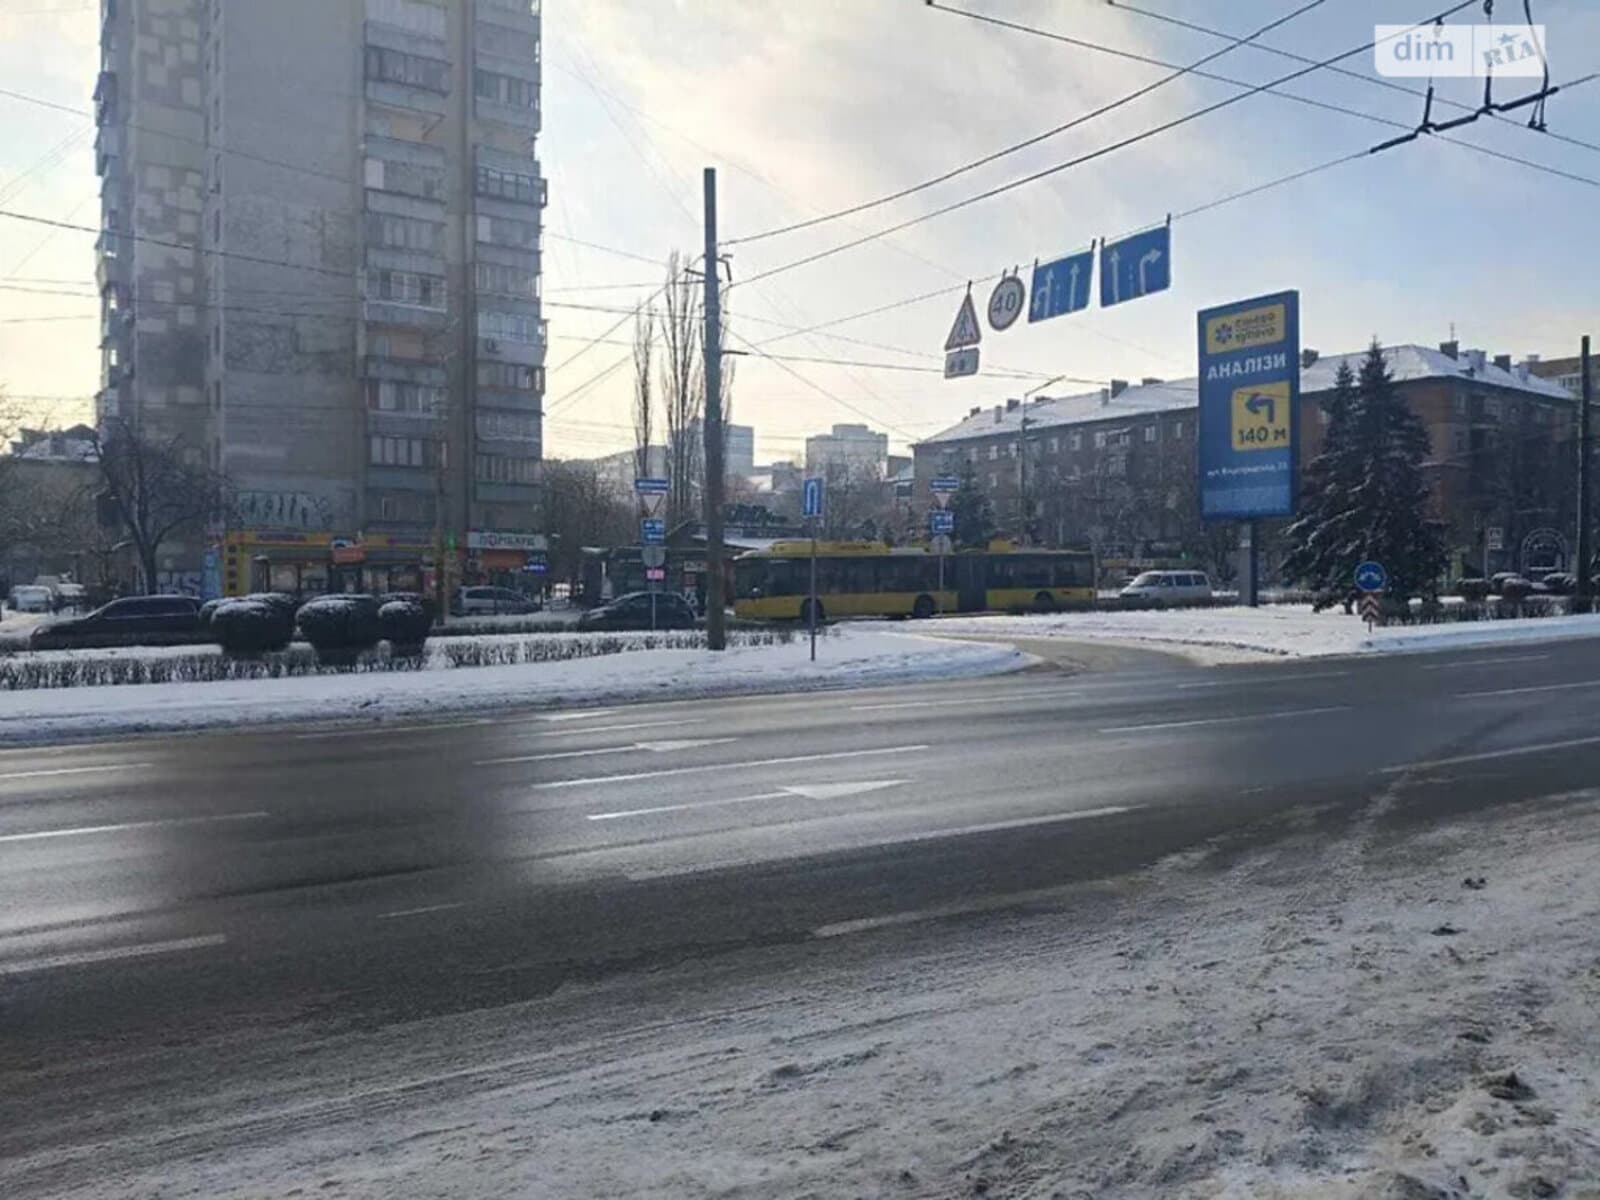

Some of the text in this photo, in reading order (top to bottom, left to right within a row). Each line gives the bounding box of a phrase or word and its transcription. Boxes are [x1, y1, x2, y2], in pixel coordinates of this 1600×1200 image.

[992, 291, 1015, 313] 40
[1207, 353, 1287, 380] АНАЛІЗИ
[1238, 426, 1269, 445] 140
